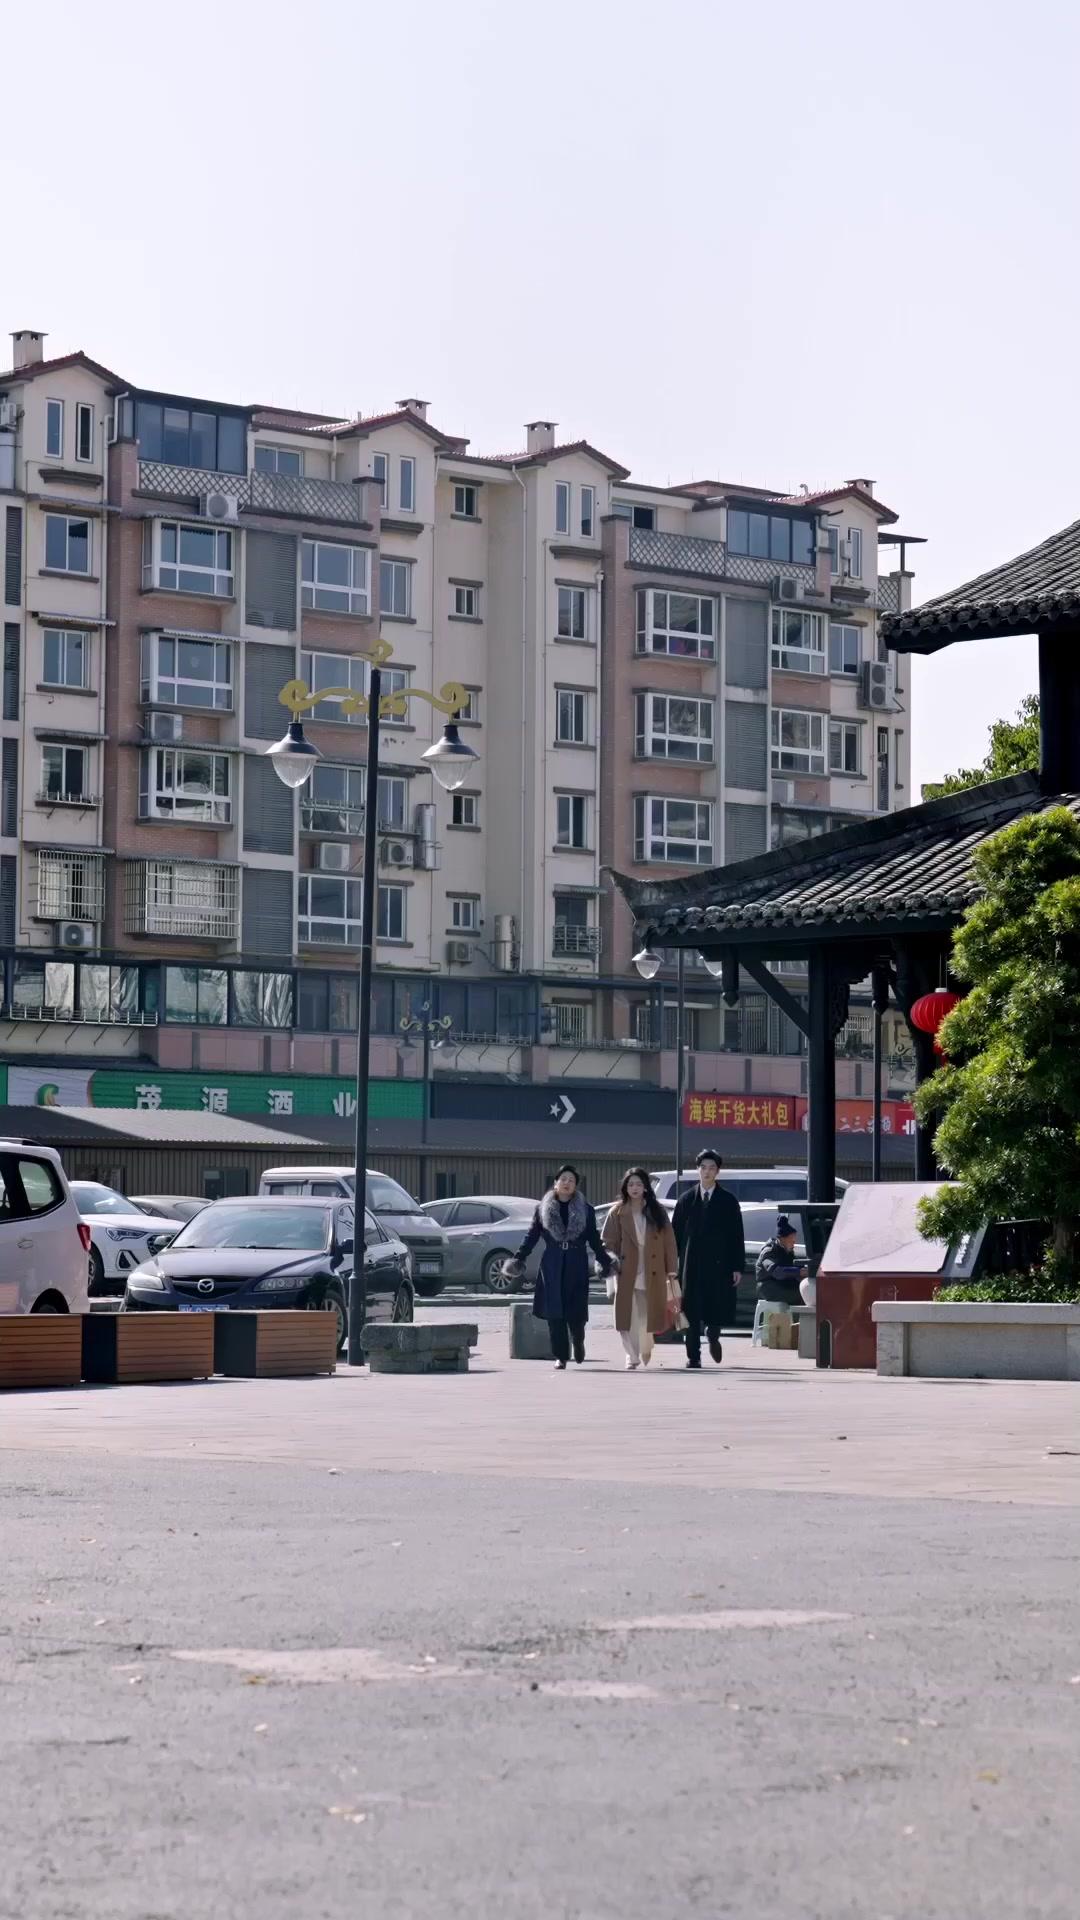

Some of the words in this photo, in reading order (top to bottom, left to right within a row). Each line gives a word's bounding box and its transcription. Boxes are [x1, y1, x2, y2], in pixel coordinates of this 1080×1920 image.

[689, 1098, 789, 1126] 海鲜干货大礼包
